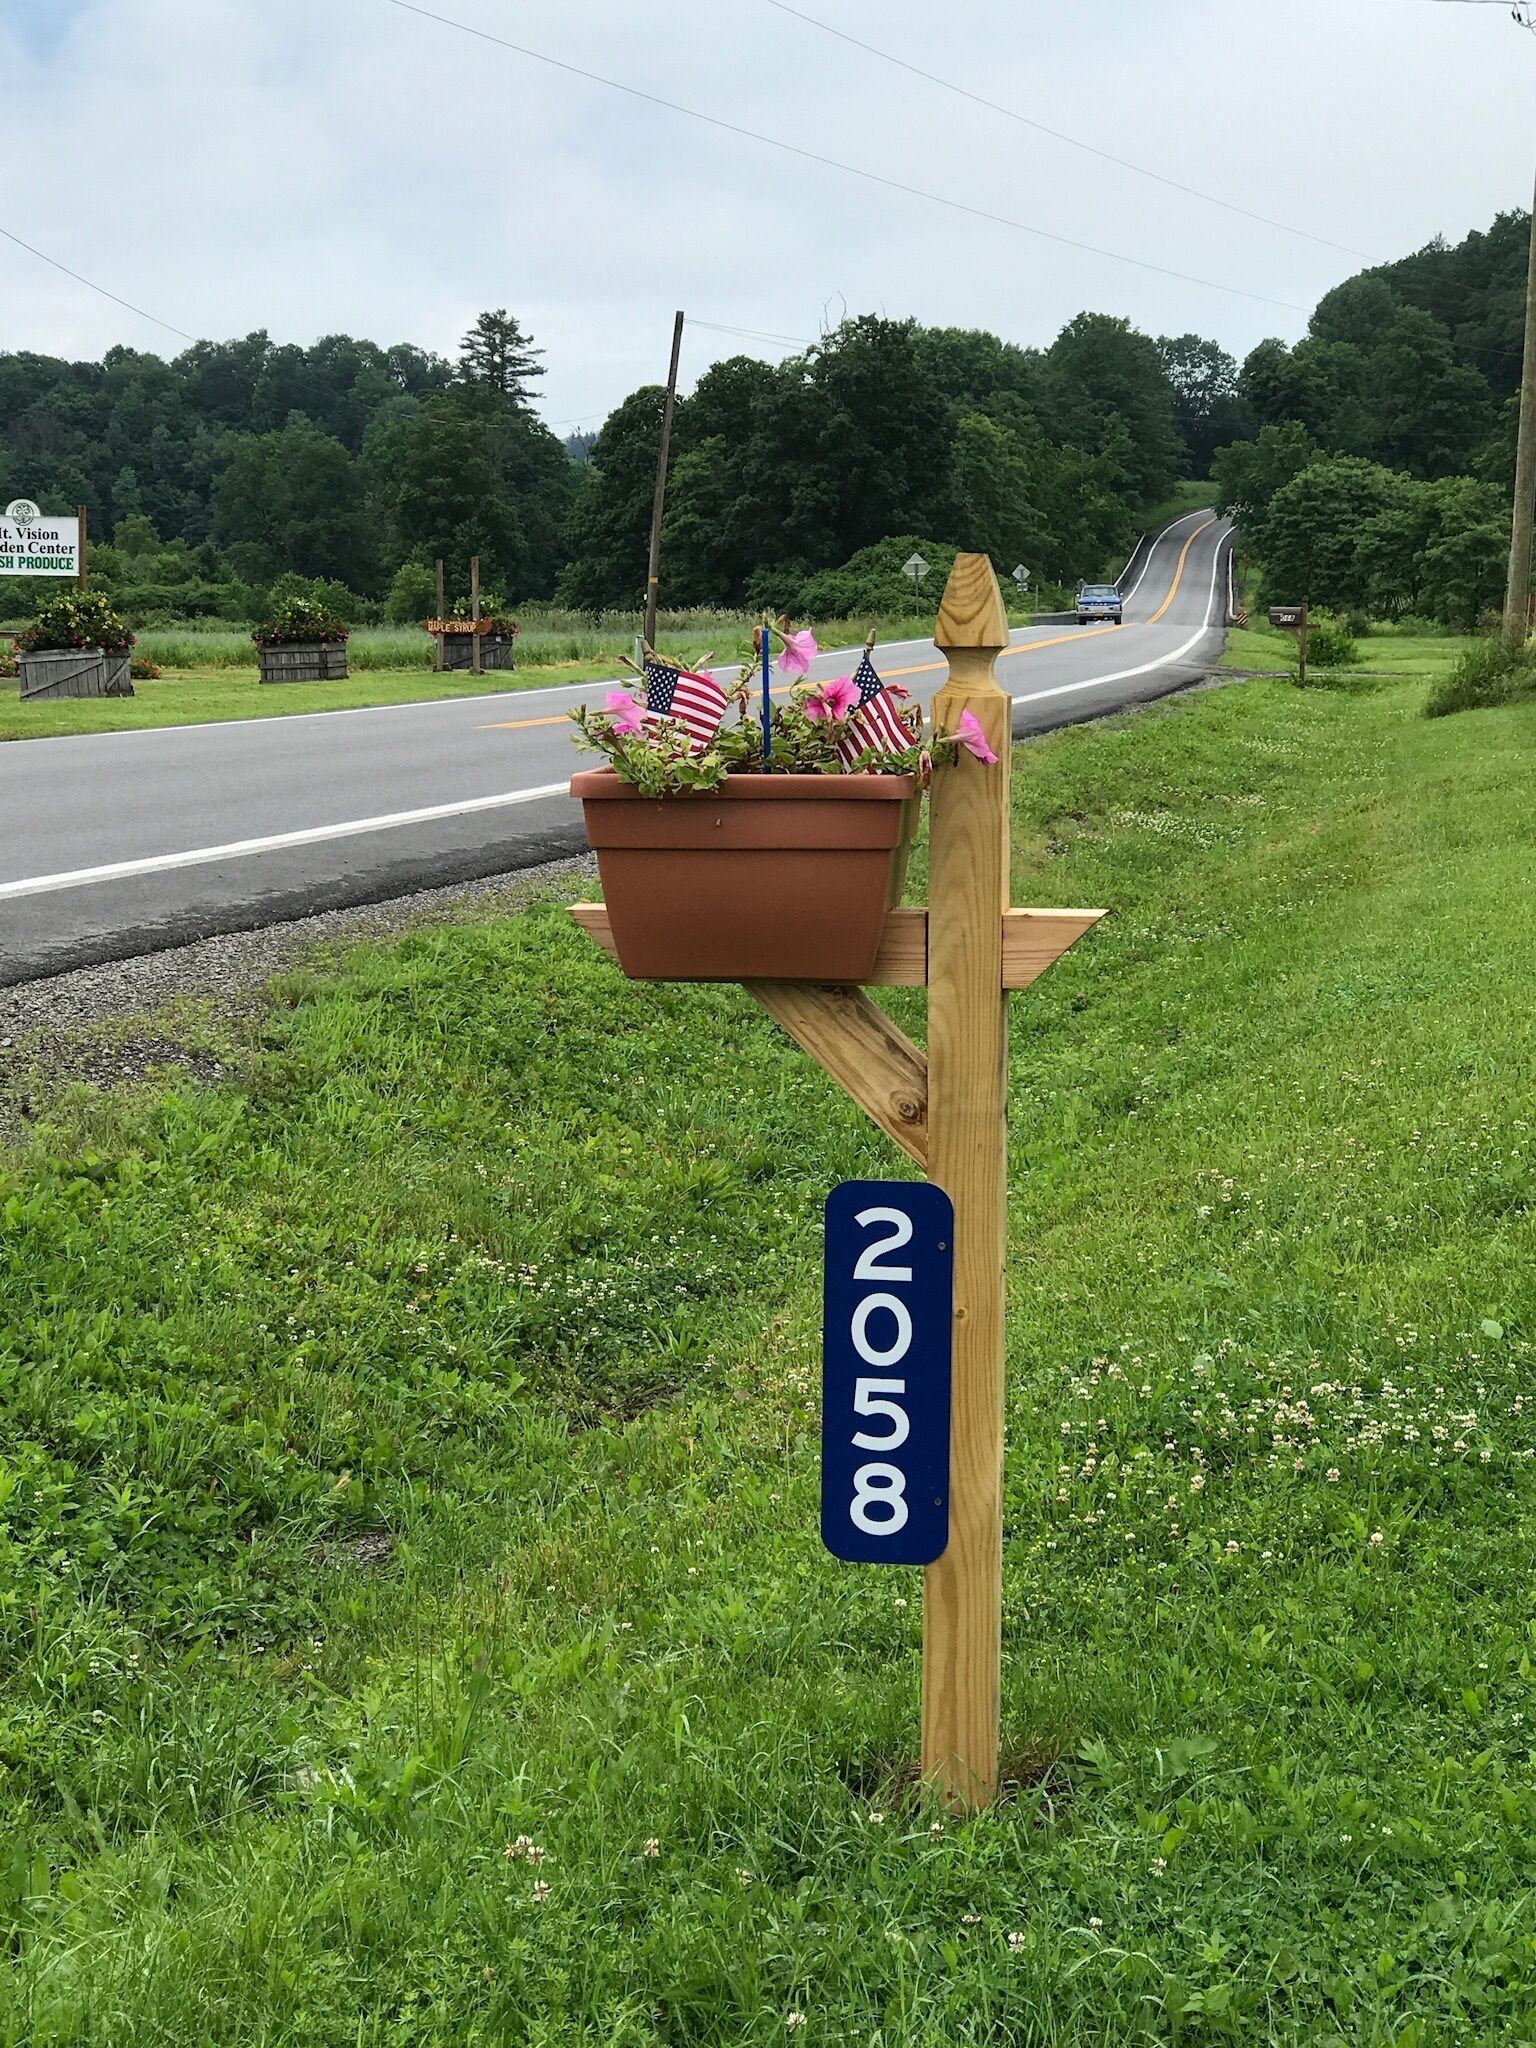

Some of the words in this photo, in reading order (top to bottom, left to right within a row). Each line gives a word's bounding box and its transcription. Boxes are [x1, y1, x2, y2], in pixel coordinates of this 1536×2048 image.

[16, 528, 59, 540] Vision
[28, 541, 75, 554] Center
[18, 556, 74, 570] PRODUCE
[428, 623, 450, 632] MAPLE
[454, 624, 476, 632] SYRUP
[850, 1206, 914, 1536] 2058
